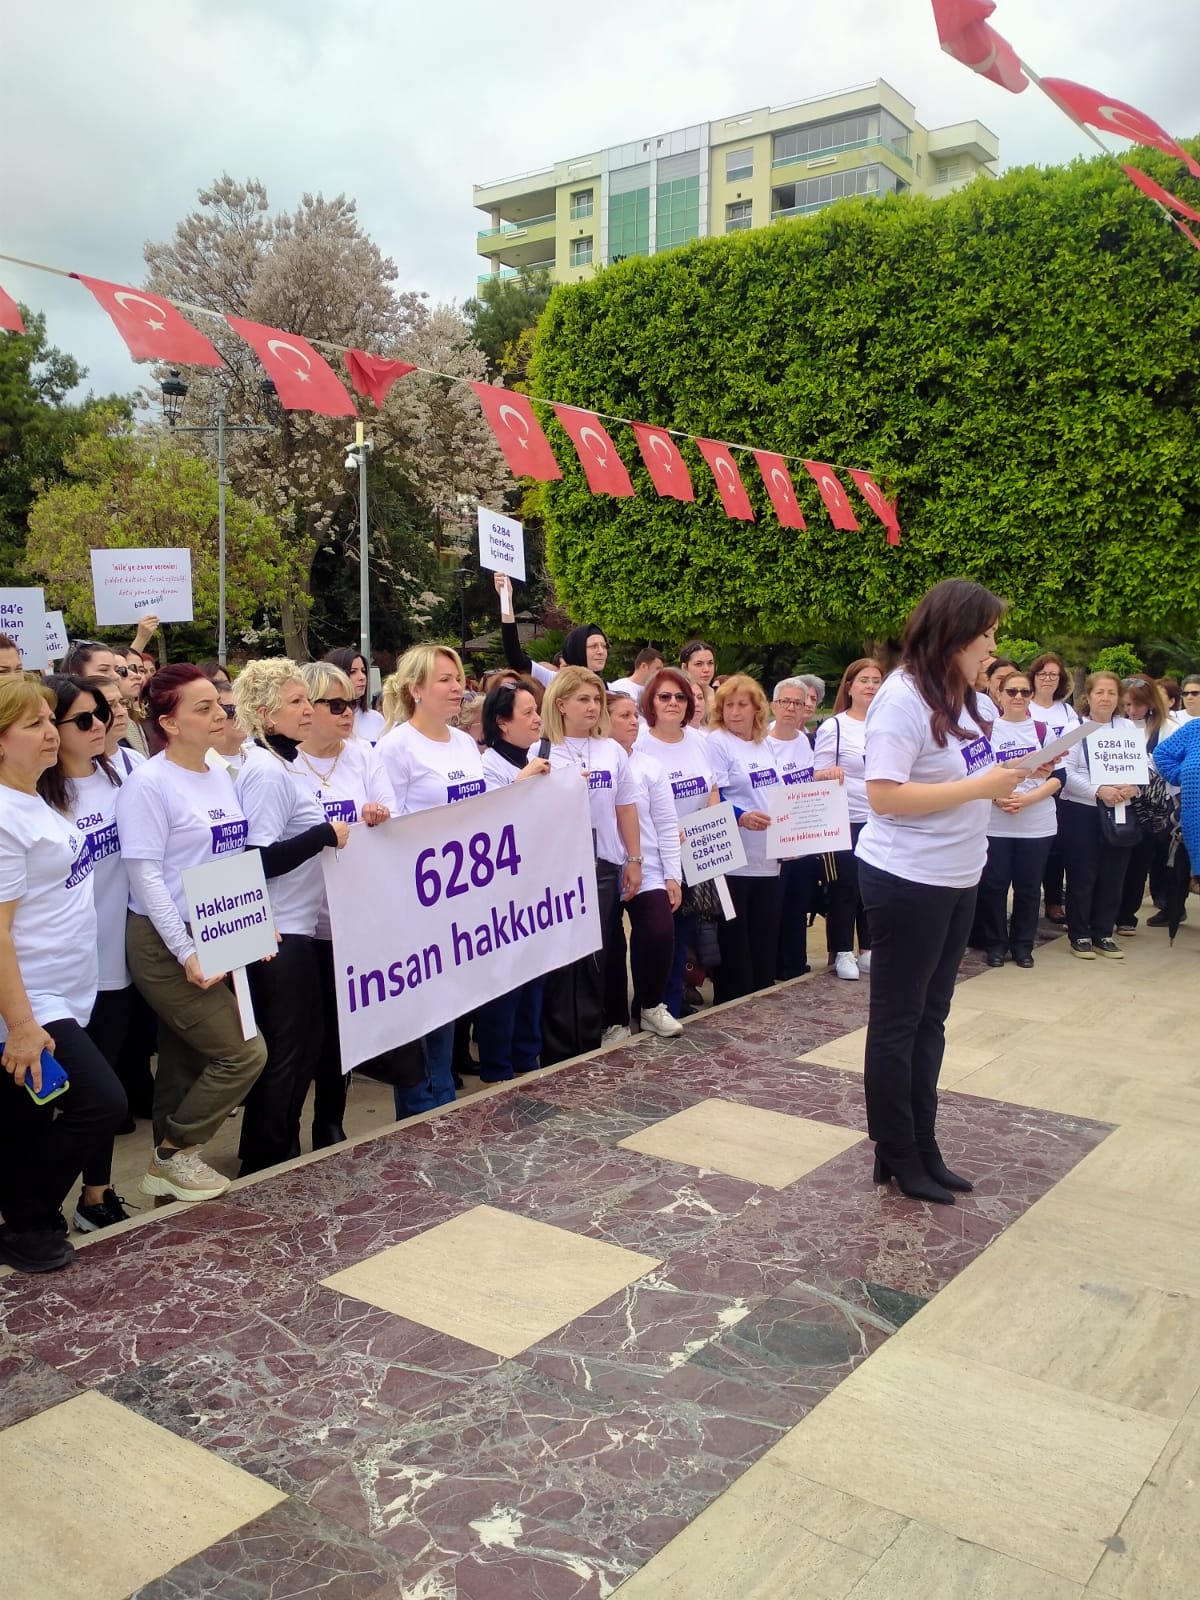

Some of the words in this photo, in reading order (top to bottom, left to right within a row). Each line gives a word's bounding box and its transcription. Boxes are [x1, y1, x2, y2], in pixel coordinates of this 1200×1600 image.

[492, 523, 511, 538] 6284
[489, 533, 515, 551] herkes
[0, 604, 24, 615] 84'e
[0, 618, 24, 628] lkan
[1097, 740, 1122, 749] 6284
[1124, 739, 1136, 749] ile
[1094, 750, 1142, 762] Sığınaksız
[1103, 762, 1135, 774] Yaşam
[459, 782, 481, 796] insan
[76, 812, 104, 830] 6284
[684, 817, 727, 838] İstismarcı
[92, 827, 119, 846] insa
[690, 830, 728, 848] değilsen
[692, 841, 732, 861] 6284'ten
[415, 824, 521, 907] 6284
[696, 851, 734, 872] korkma!
[195, 888, 264, 921] Haklarıma
[200, 905, 268, 943] dokunma!
[346, 943, 443, 1013] insan
[451, 876, 587, 967] hakkıdır!
